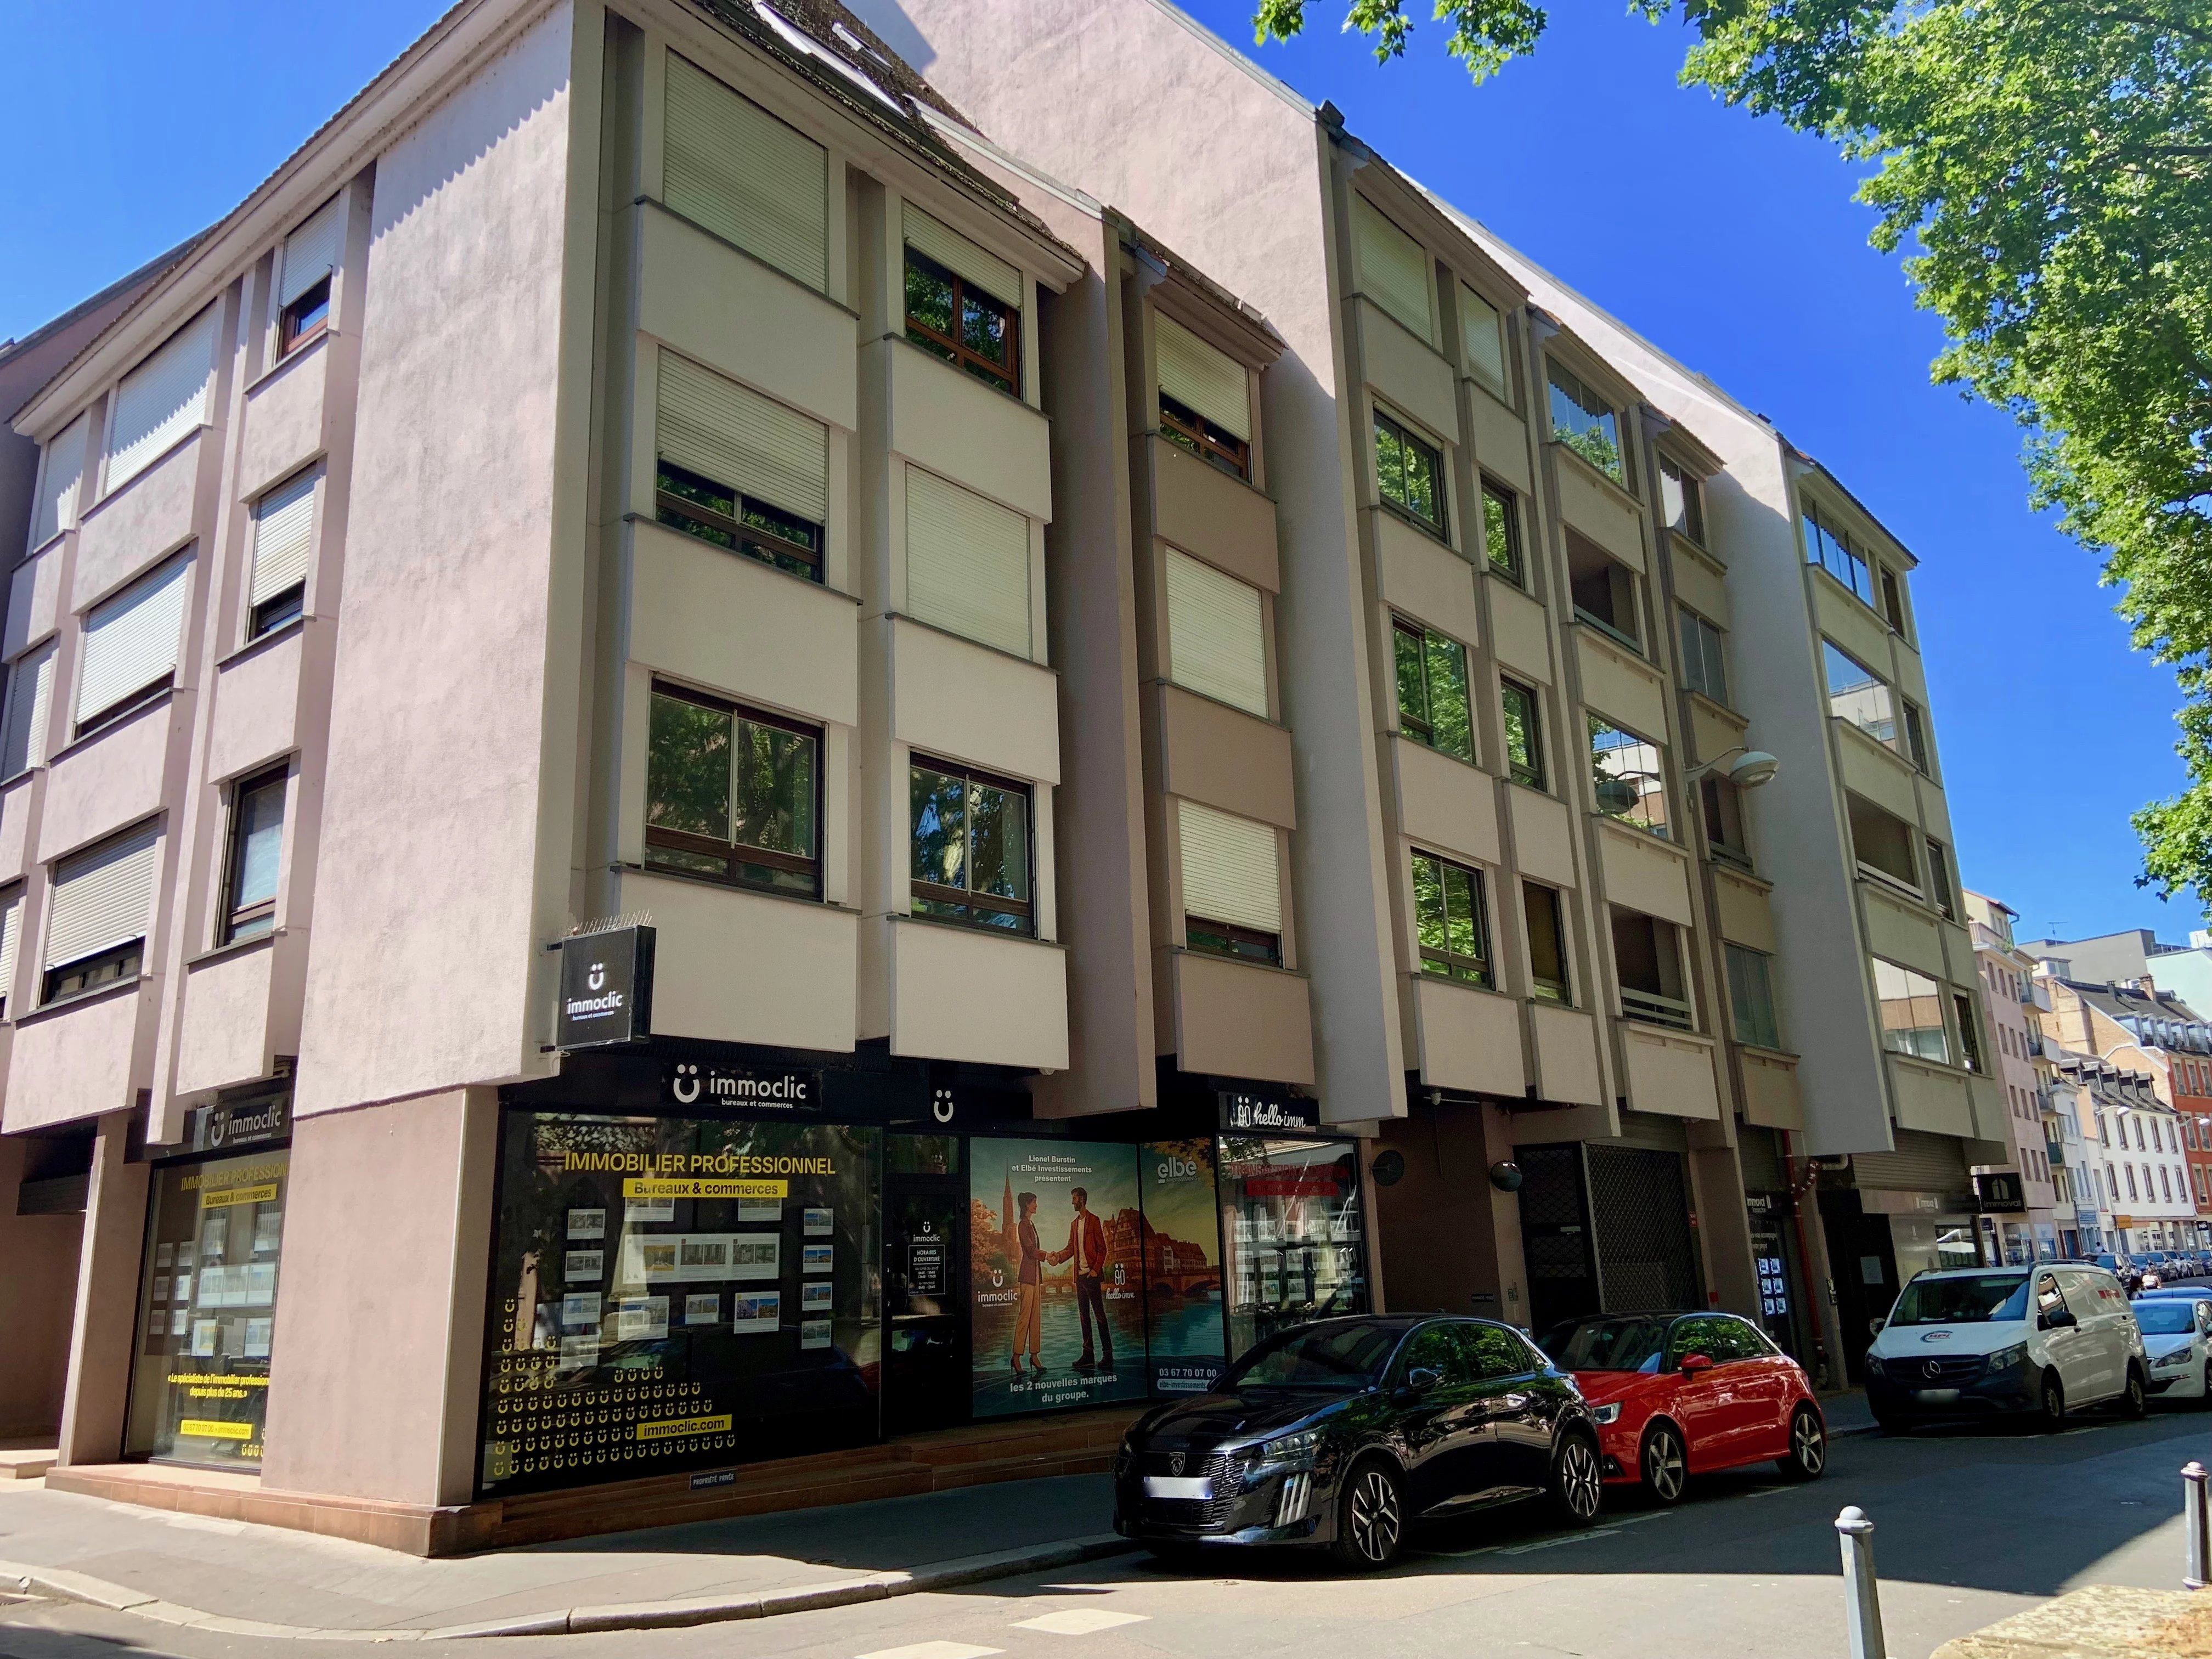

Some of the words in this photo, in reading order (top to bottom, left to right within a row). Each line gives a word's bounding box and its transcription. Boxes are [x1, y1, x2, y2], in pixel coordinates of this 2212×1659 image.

[567, 991, 623, 1014] immoclic
[710, 1070, 806, 1099] immoclic
[721, 1098, 748, 1106] bureaux
[228, 1105, 281, 1135] immoclic
[1254, 1102, 1283, 1126] hello
[1284, 1111, 1306, 1128] imm
[565, 1152, 685, 1172] IMMOBILIER
[690, 1155, 836, 1175] PROFESSIONNEL
[1051, 1155, 1076, 1164] Burstin
[1158, 1156, 1197, 1178] elbé
[181, 1171, 229, 1192] IMMOBILIER
[231, 1163, 289, 1183] PROFESSION
[1034, 1175, 1071, 1183] présentent
[635, 1182, 689, 1195] Bureaux
[692, 1182, 701, 1195] &
[705, 1183, 778, 1195] commerces
[206, 1194, 229, 1205] Bureaux
[230, 1192, 234, 1202] &
[236, 1189, 272, 1201] commerces
[1984, 1199, 2022, 1207] immoval
[913, 1234, 940, 1242] immoclic
[978, 1289, 1018, 1302] immoclic
[1106, 1288, 1121, 1300] hello
[177, 1373, 203, 1385] spécialiste
[203, 1374, 210, 1384] de
[1159, 1368, 1169, 1376] 03
[1171, 1368, 1181, 1377] 67
[1182, 1369, 1193, 1377] 70
[1194, 1369, 1204, 1377] 07
[1206, 1369, 1217, 1378] 00
[1010, 1383, 1024, 1392] les
[1026, 1381, 1032, 1391] 2
[1035, 1378, 1078, 1390] nouvelles
[1080, 1374, 1118, 1385] marques
[189, 1386, 206, 1398] depuis
[206, 1387, 217, 1398] plus
[217, 1387, 224, 1397] de
[225, 1387, 233, 1397] 25
[1042, 1393, 1053, 1402] du
[1056, 1391, 1089, 1403] groupe.
[196, 1424, 201, 1432] 70
[218, 1426, 249, 1435] immoclic.com
[644, 1419, 725, 1436] immoclic.com
[693, 1475, 717, 1486] PROPRIÉTÉ
[719, 1472, 735, 1482] PRIVÉE
